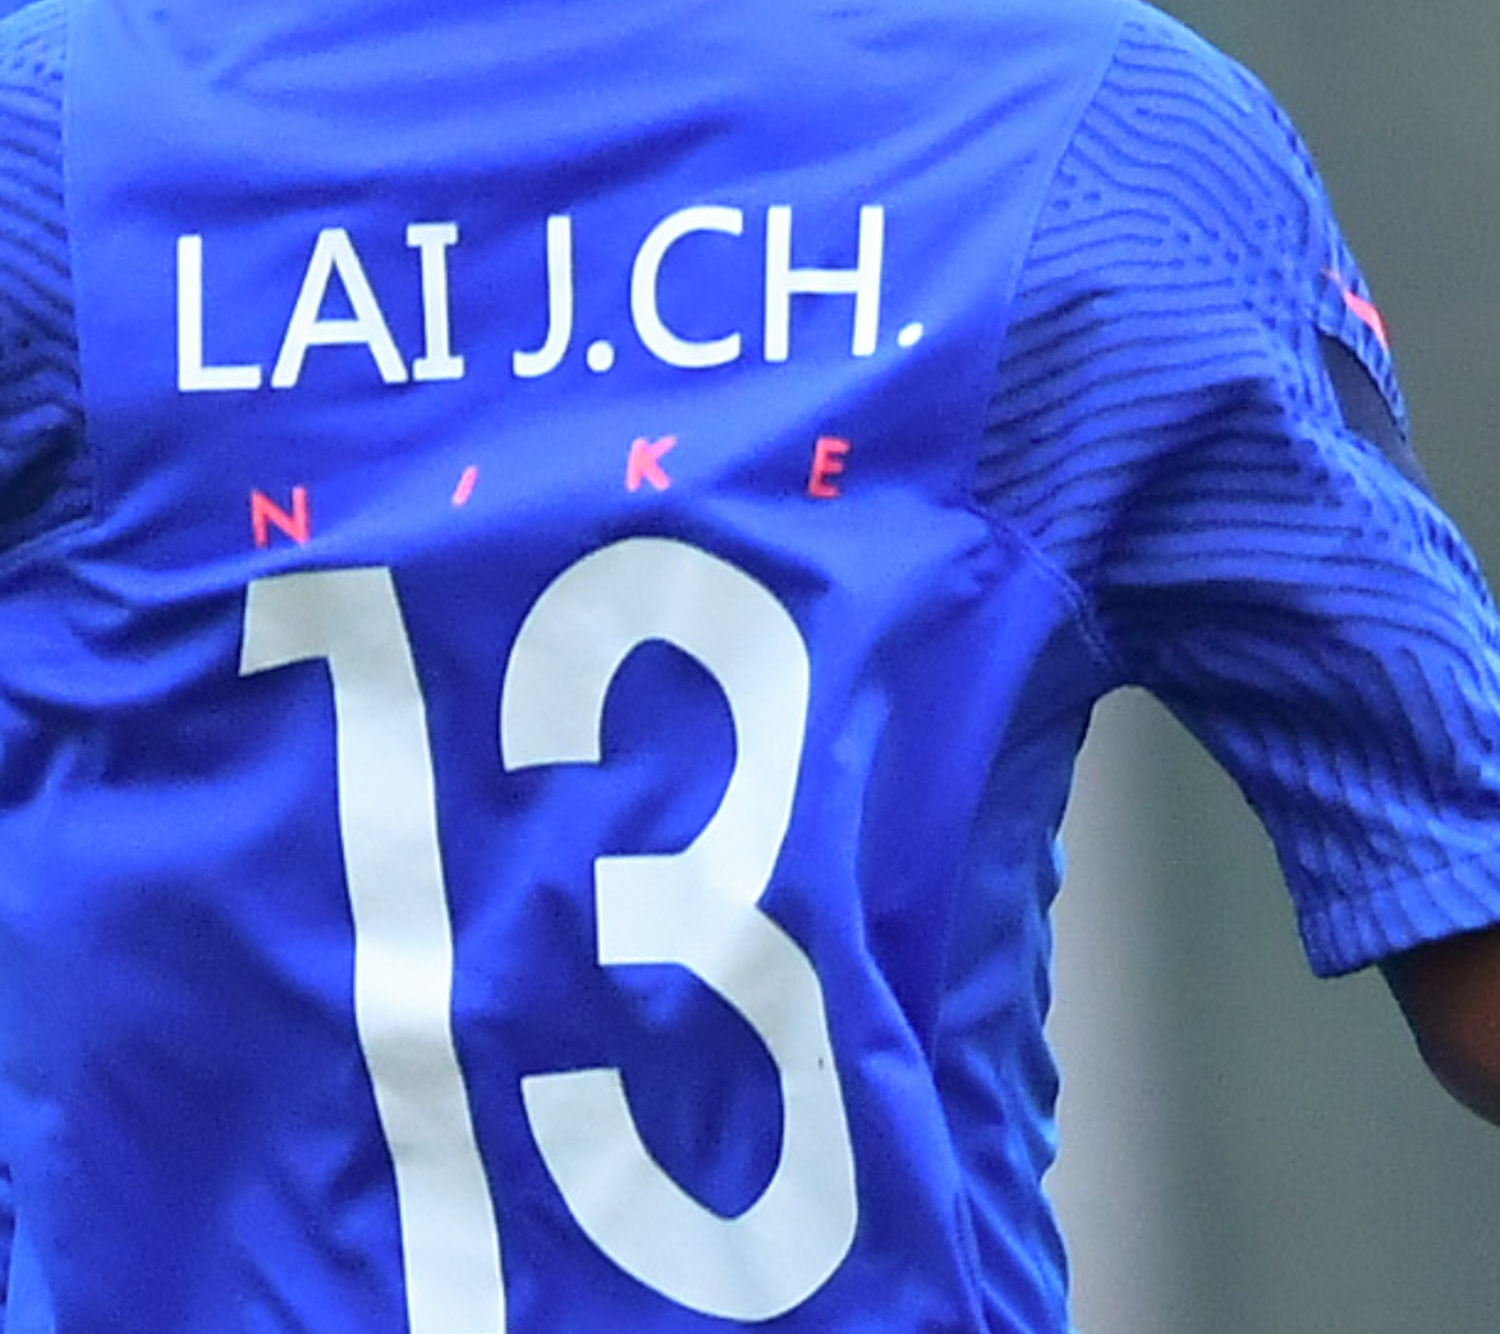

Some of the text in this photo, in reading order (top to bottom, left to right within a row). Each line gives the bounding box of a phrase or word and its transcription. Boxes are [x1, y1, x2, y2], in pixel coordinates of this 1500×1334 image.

[175, 204, 926, 393] LAI J.CH.
[248, 435, 852, 548] NIKE
